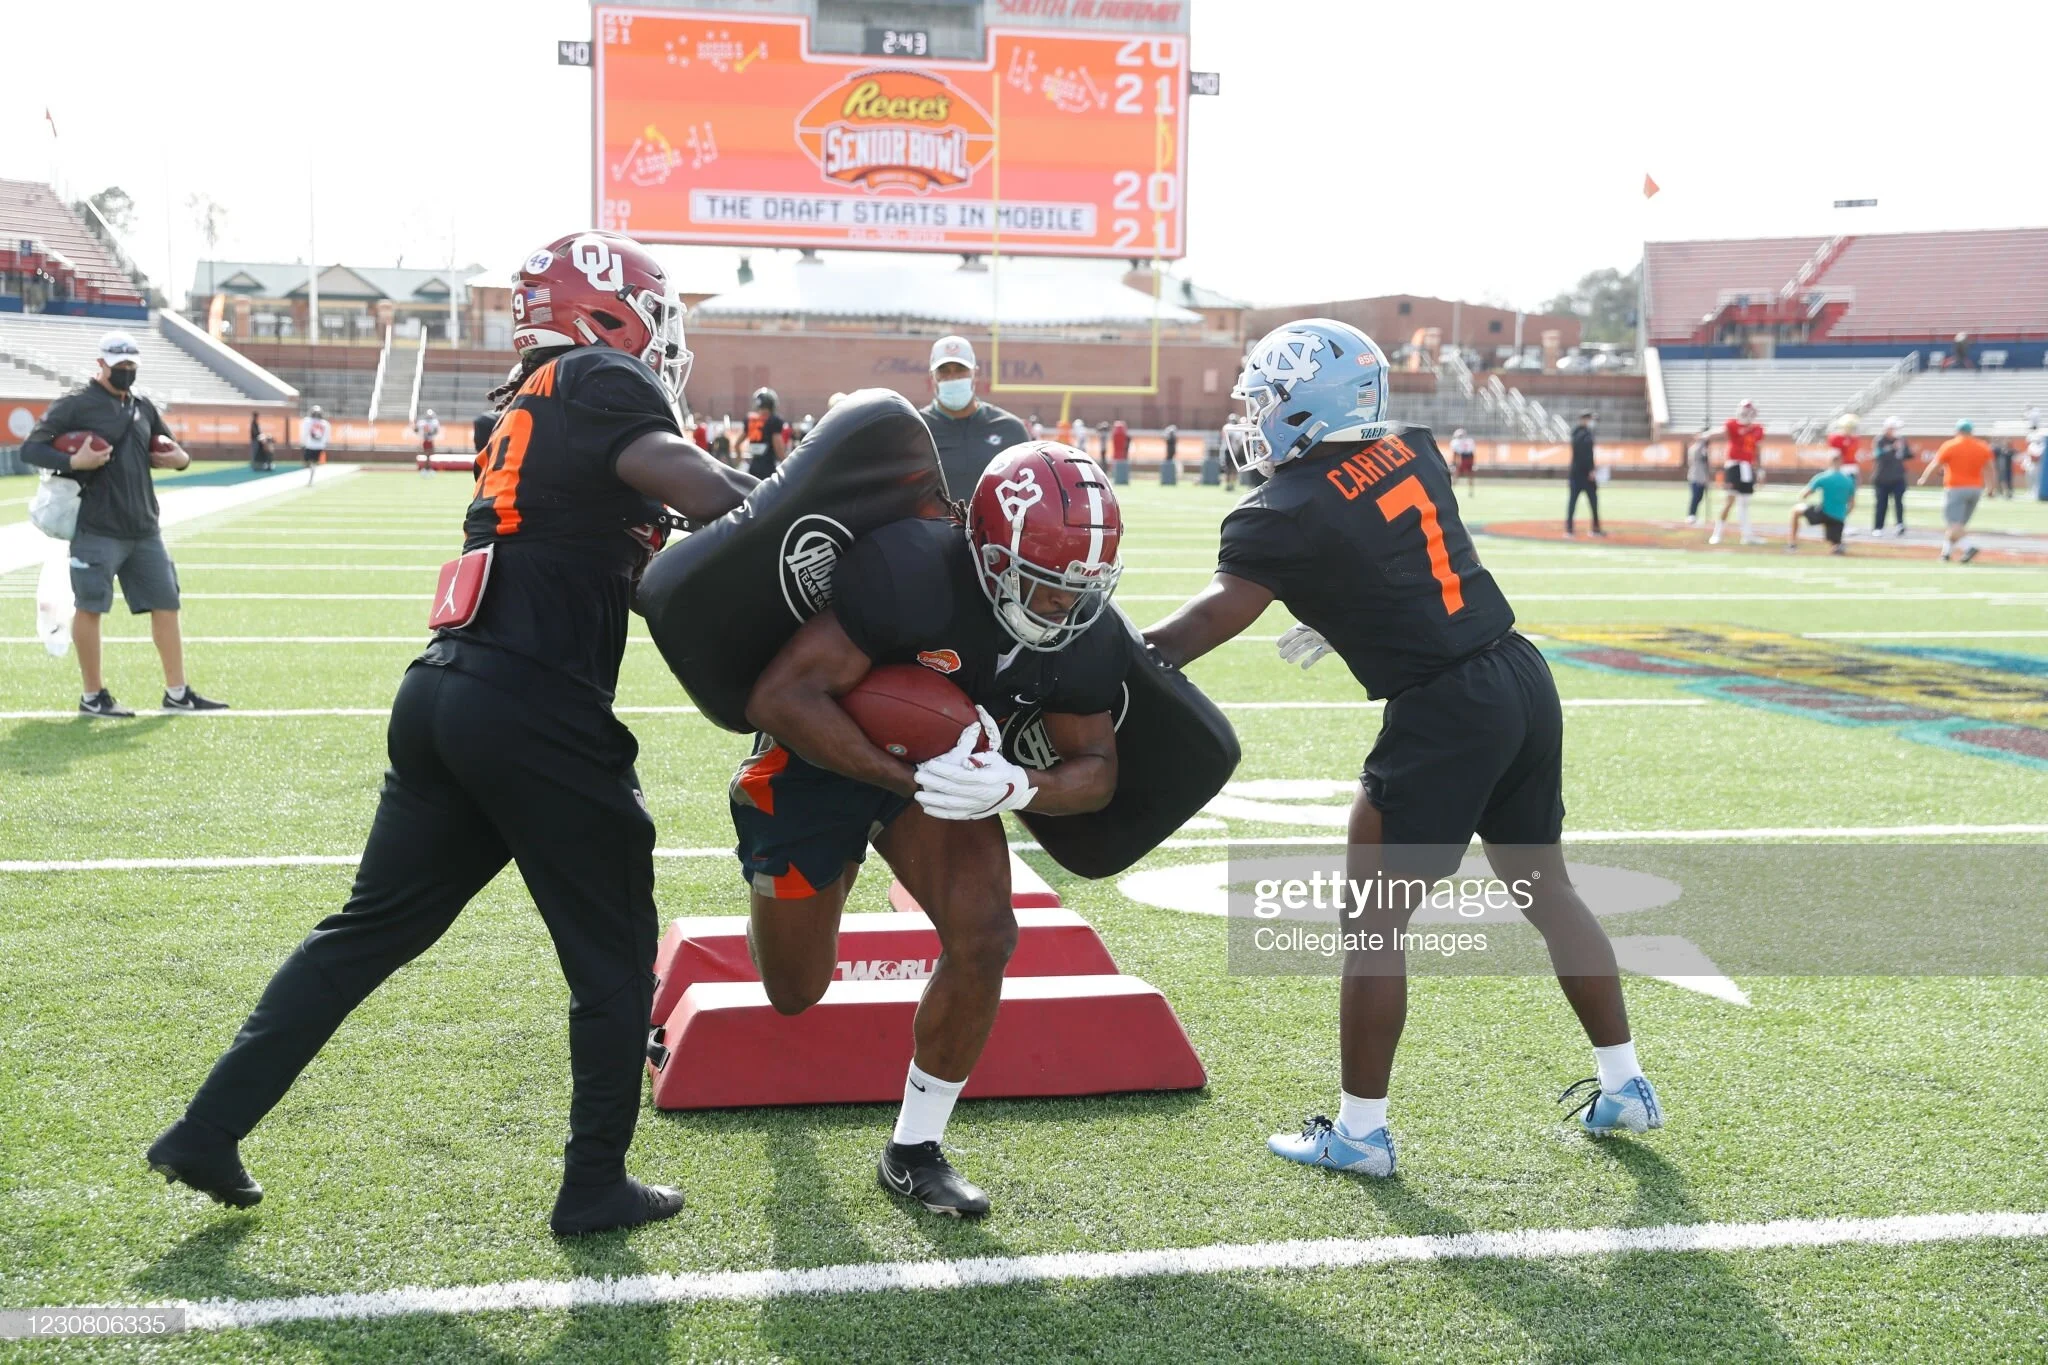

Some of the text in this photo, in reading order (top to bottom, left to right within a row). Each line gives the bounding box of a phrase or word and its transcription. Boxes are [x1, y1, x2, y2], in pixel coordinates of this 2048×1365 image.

[841, 80, 952, 121] Reese's
[1114, 73, 1176, 115] 21
[826, 127, 967, 182] SENIOR BOWL
[1112, 170, 1177, 212] 20
[705, 194, 1084, 232] THE DRAFT STARTS IN MOBILE
[530, 254, 549, 269] 44
[1327, 433, 1417, 501] CARTER
[1375, 474, 1465, 616] 7
[800, 567, 820, 597] TEAM
